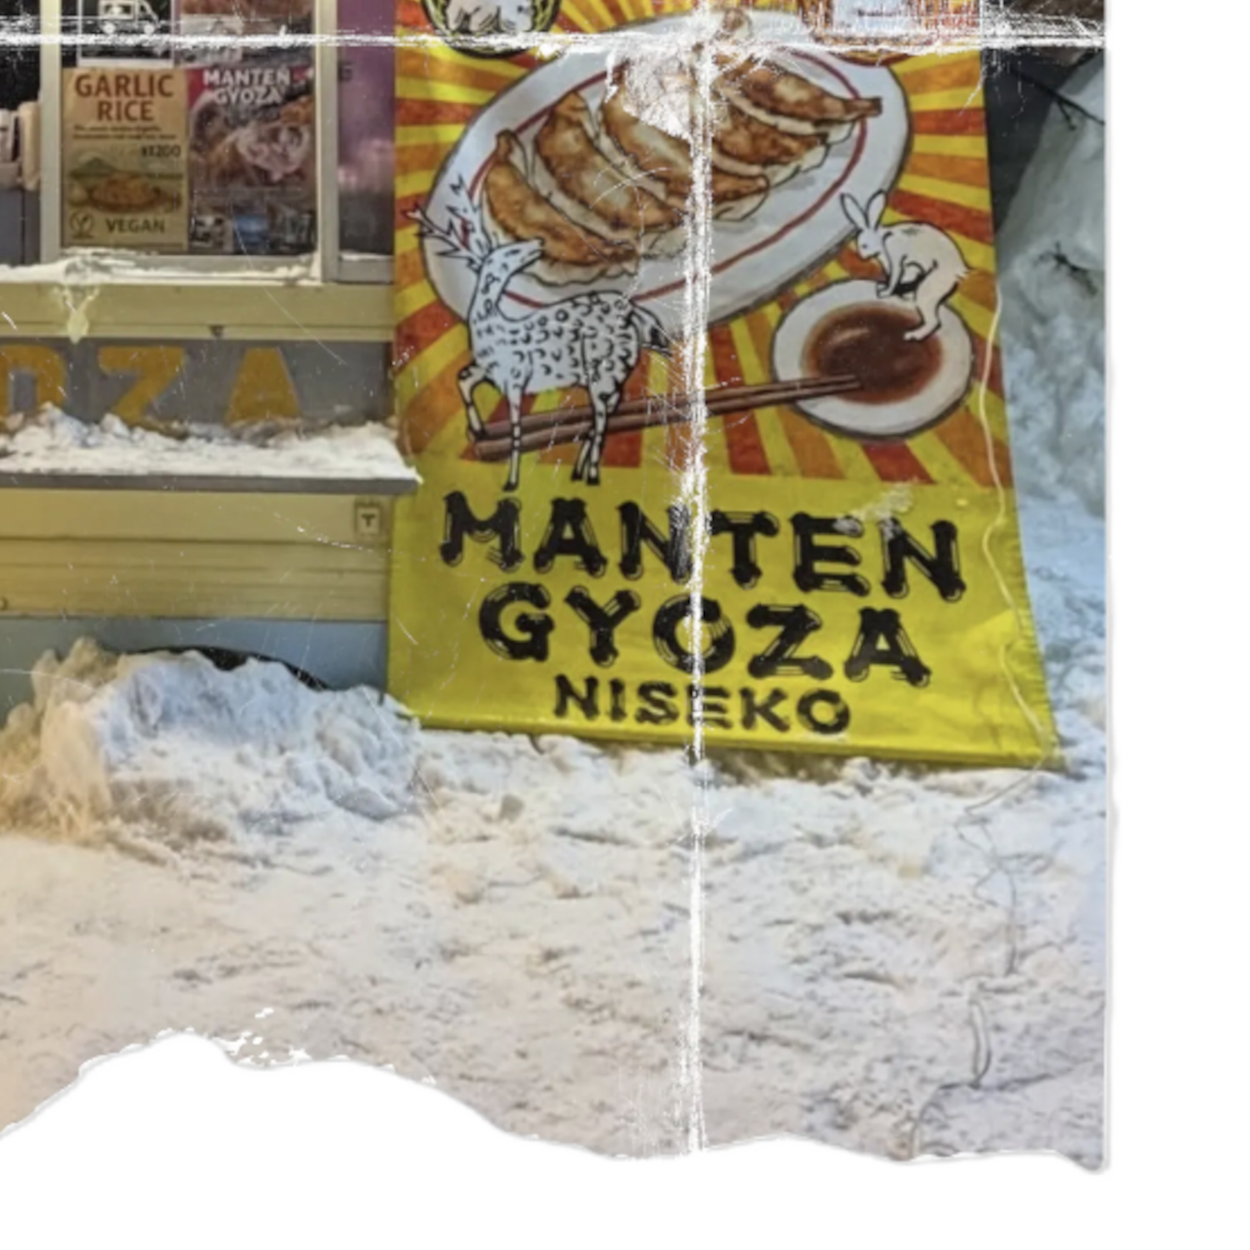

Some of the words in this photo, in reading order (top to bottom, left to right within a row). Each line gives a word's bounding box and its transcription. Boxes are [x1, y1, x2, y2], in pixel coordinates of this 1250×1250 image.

[75, 73, 174, 98] GARLIC
[203, 69, 290, 87] MANTEN
[215, 87, 282, 105] GYOZA
[97, 100, 155, 122] RICE
[105, 218, 166, 234] VEGAN
[439, 490, 968, 603] MANTEN
[478, 581, 932, 688] GYOZA
[553, 672, 853, 735] NISEKO
